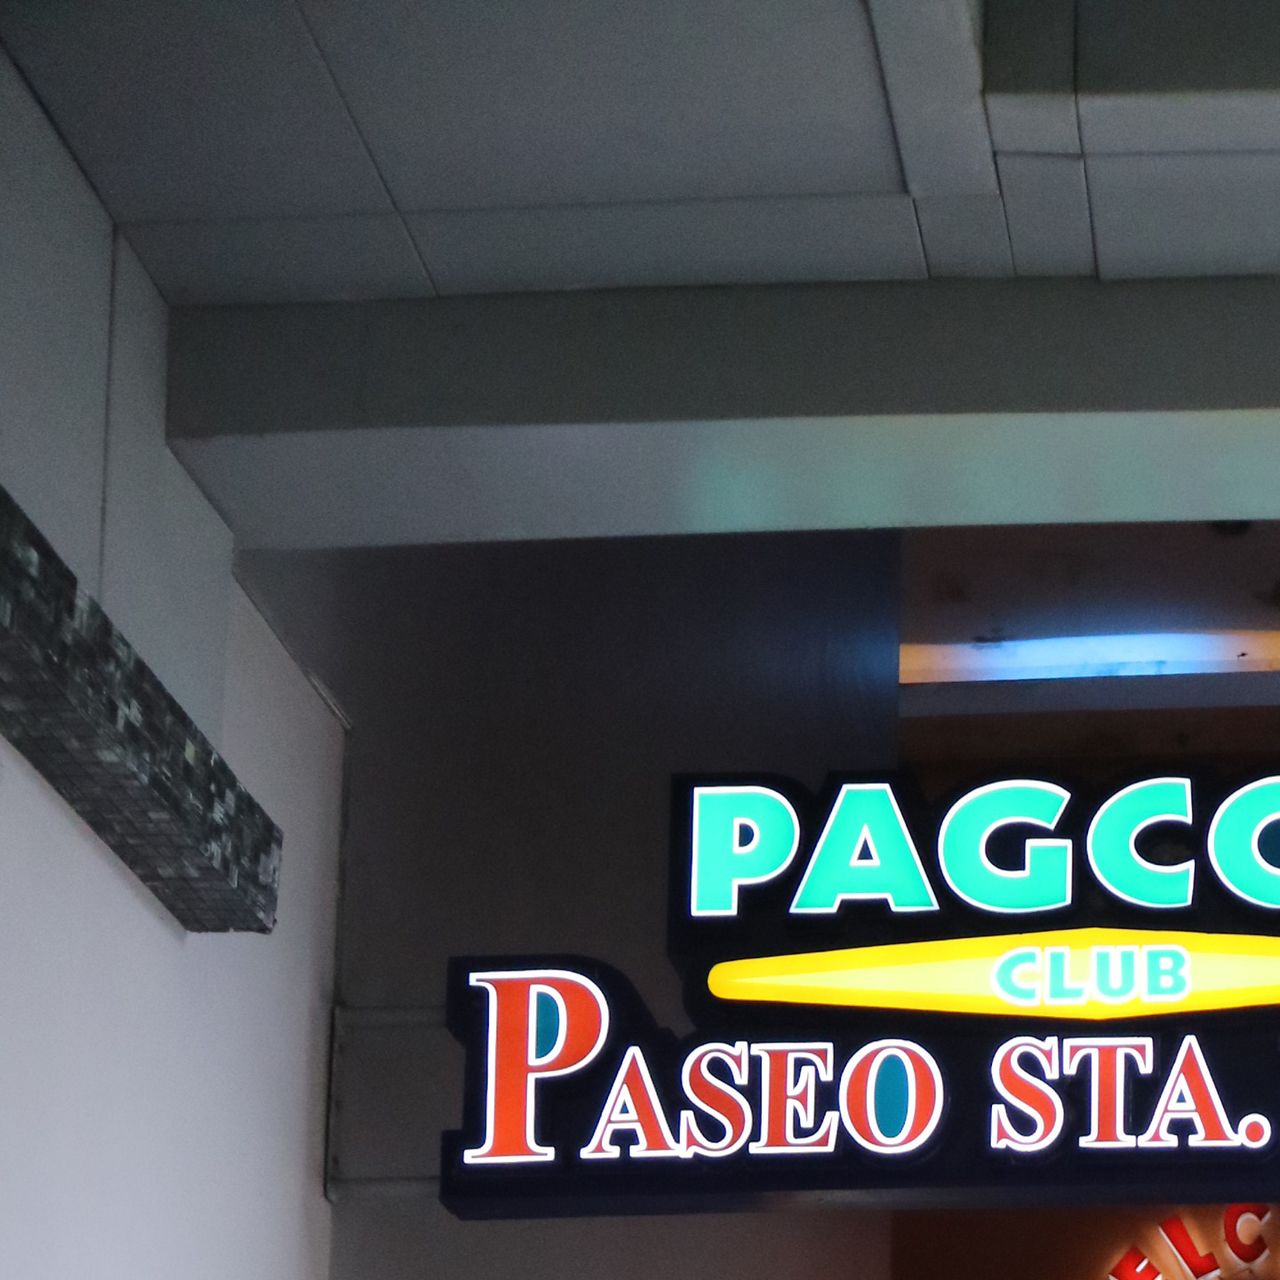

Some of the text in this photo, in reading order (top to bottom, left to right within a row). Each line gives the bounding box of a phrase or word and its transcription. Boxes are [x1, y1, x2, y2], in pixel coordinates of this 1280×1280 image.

[994, 946, 1189, 1006] CLUB
[464, 966, 943, 1163] PASEO
[990, 1035, 1266, 1153] STA.
